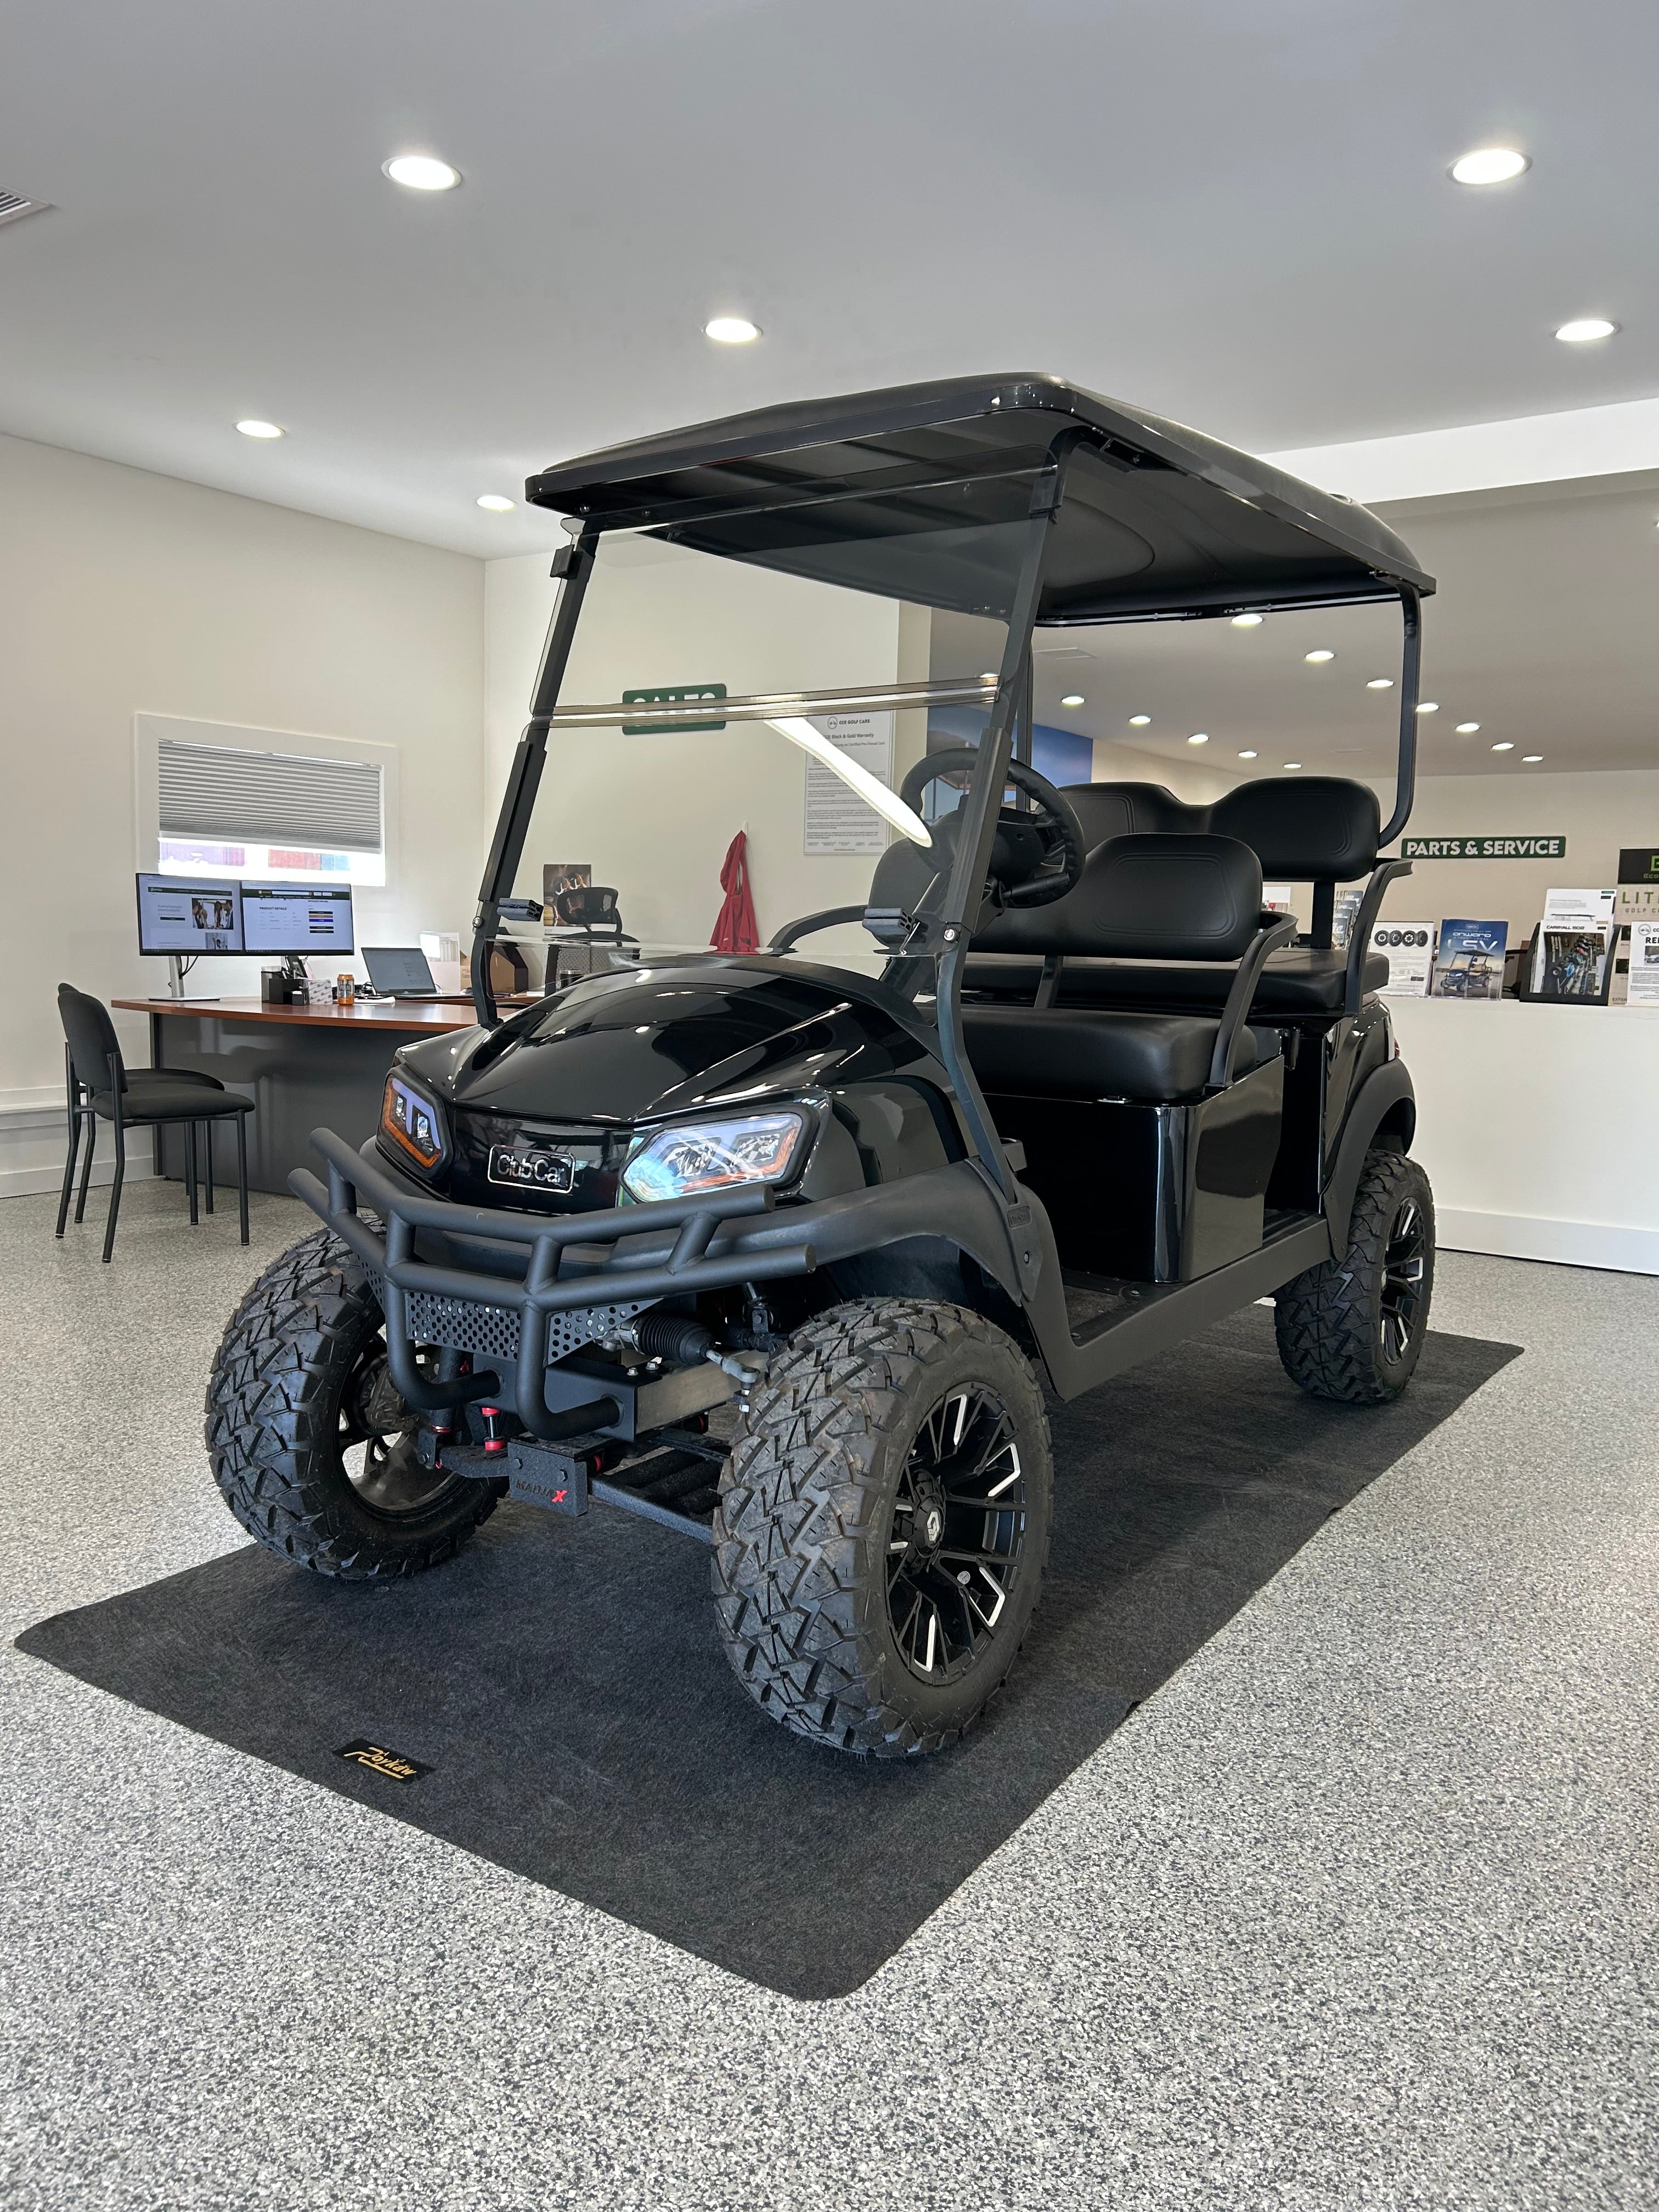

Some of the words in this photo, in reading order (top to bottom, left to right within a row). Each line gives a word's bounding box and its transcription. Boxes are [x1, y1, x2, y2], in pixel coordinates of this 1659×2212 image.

[1407, 840, 1461, 856] PARTS
[1465, 840, 1479, 855] &
[1483, 839, 1560, 855] SERVICE
[1622, 891, 1659, 904] LIT
[1447, 939, 1498, 951] LSV
